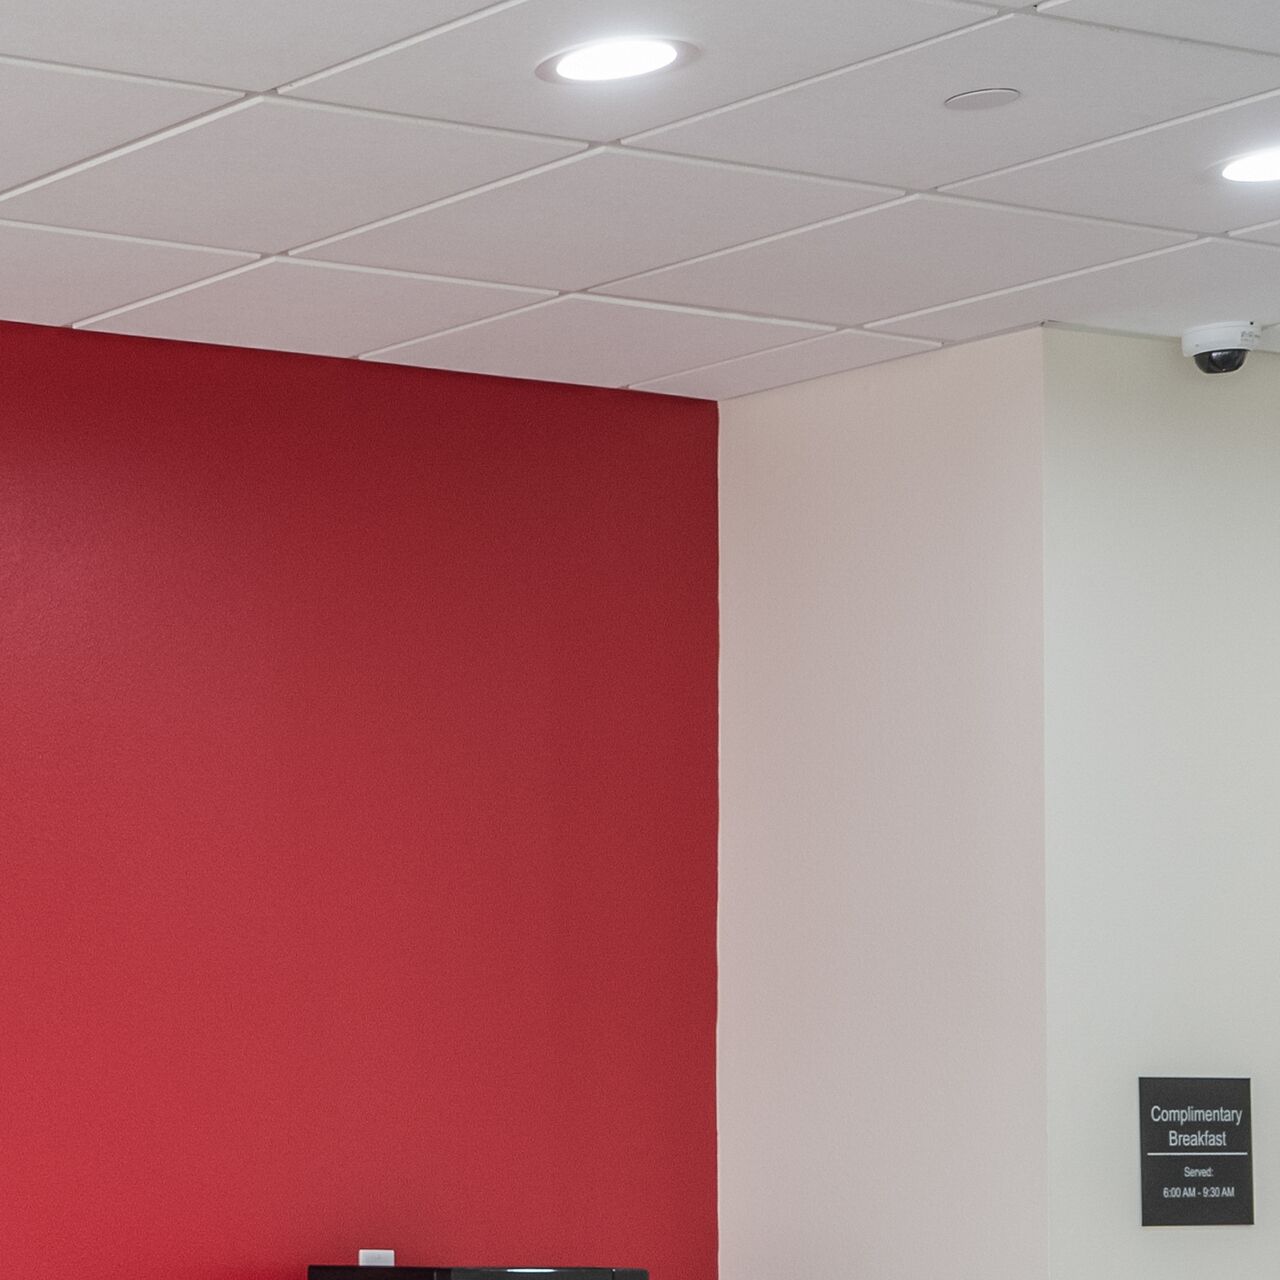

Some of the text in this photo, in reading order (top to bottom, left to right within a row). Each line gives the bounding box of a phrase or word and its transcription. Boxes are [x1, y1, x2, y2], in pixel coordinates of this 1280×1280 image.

[1150, 1105, 1243, 1126] Complimentary
[1168, 1130, 1227, 1146] Breakfast
[1183, 1166, 1214, 1177] Served:
[1162, 1187, 1182, 1198] 6:00
[1182, 1187, 1196, 1198] AM
[1203, 1186, 1220, 1198] 9:30
[1221, 1186, 1235, 1197] AM
